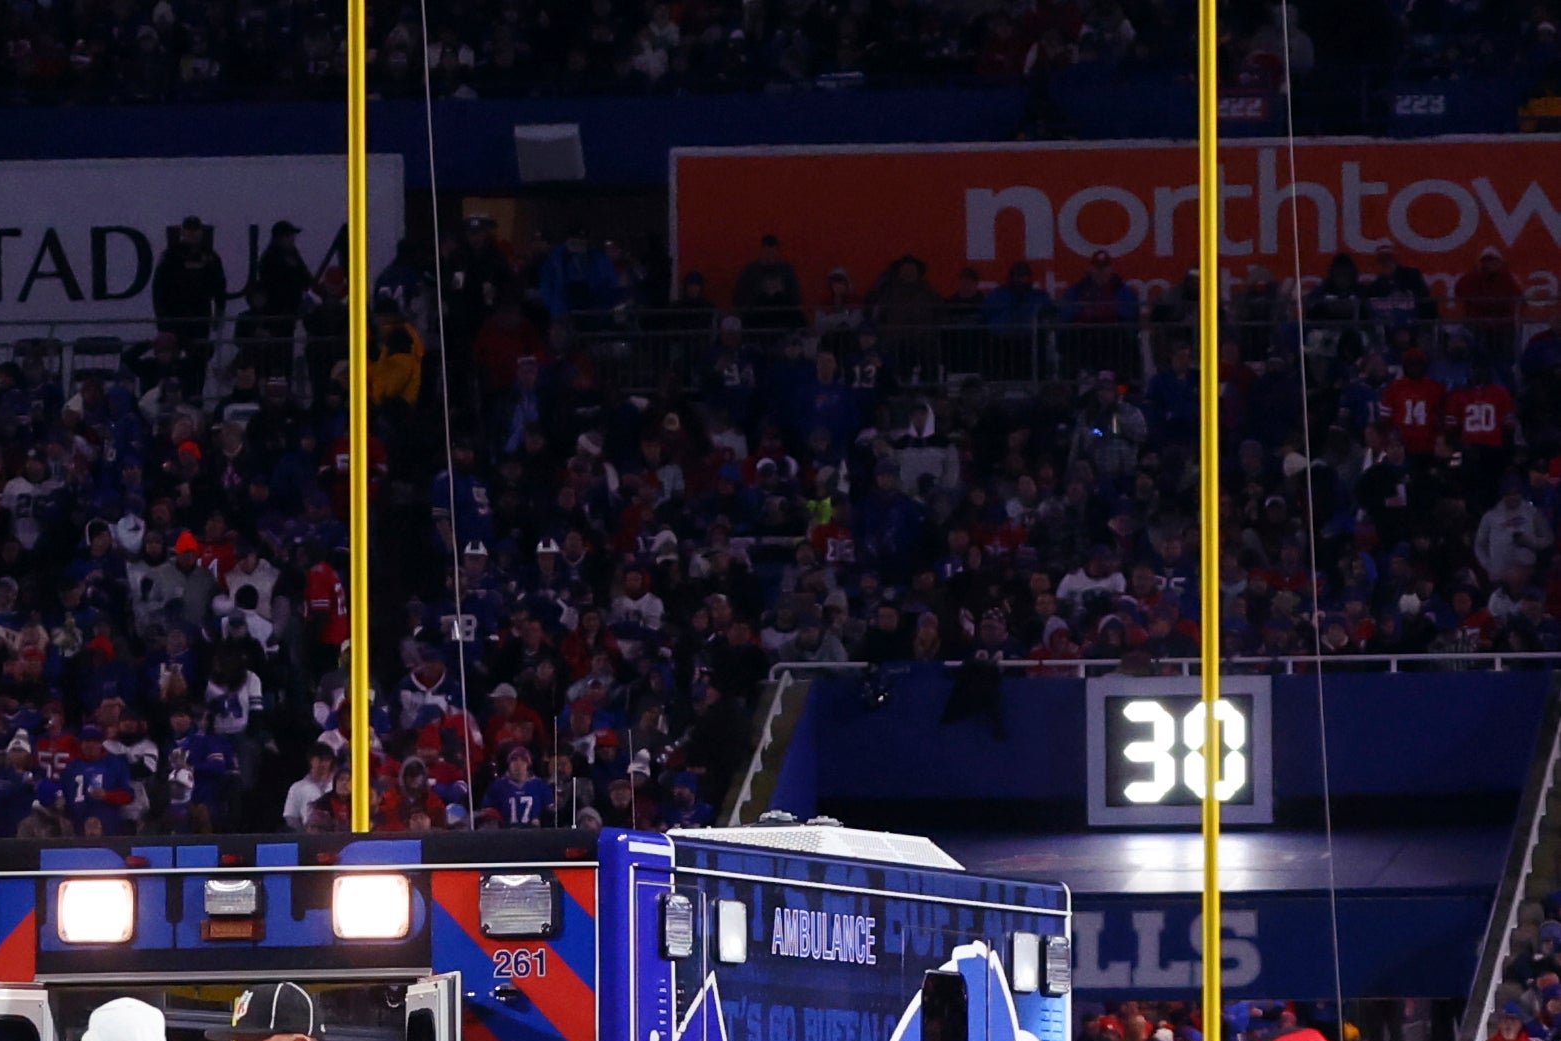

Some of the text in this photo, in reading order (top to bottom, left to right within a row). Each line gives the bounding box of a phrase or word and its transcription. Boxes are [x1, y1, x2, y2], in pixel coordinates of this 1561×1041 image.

[1395, 95, 1444, 115] 223
[1404, 400, 1426, 425] 14
[1465, 403, 1496, 432] 20
[38, 752, 70, 778] 55
[1122, 699, 1247, 803] 30
[508, 795, 533, 823] 17
[771, 906, 877, 967] AMBULANCE
[493, 947, 547, 979] 261
